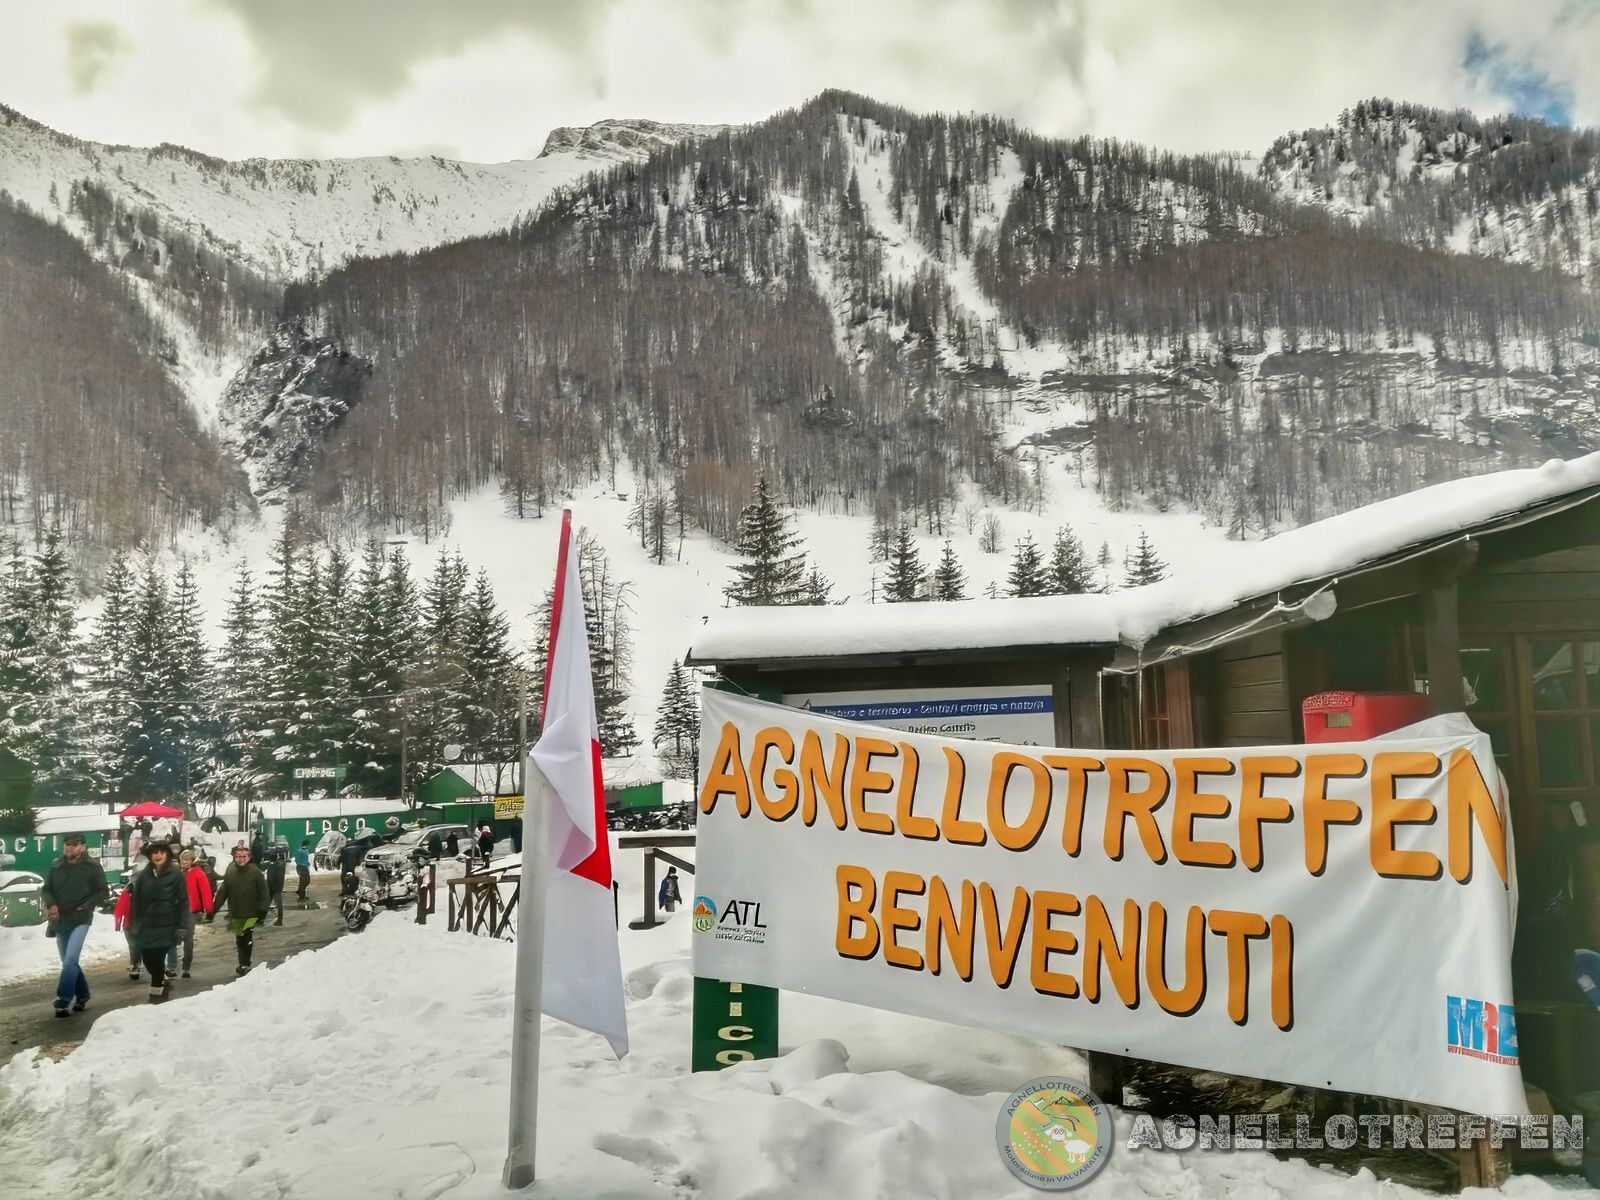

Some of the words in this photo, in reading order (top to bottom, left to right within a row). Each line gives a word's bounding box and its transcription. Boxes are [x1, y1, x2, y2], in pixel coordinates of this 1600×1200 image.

[700, 721, 1509, 890] AGNELLOTREFFEN
[719, 899, 767, 928] ATL
[836, 864, 1295, 1032] BENVENUTI
